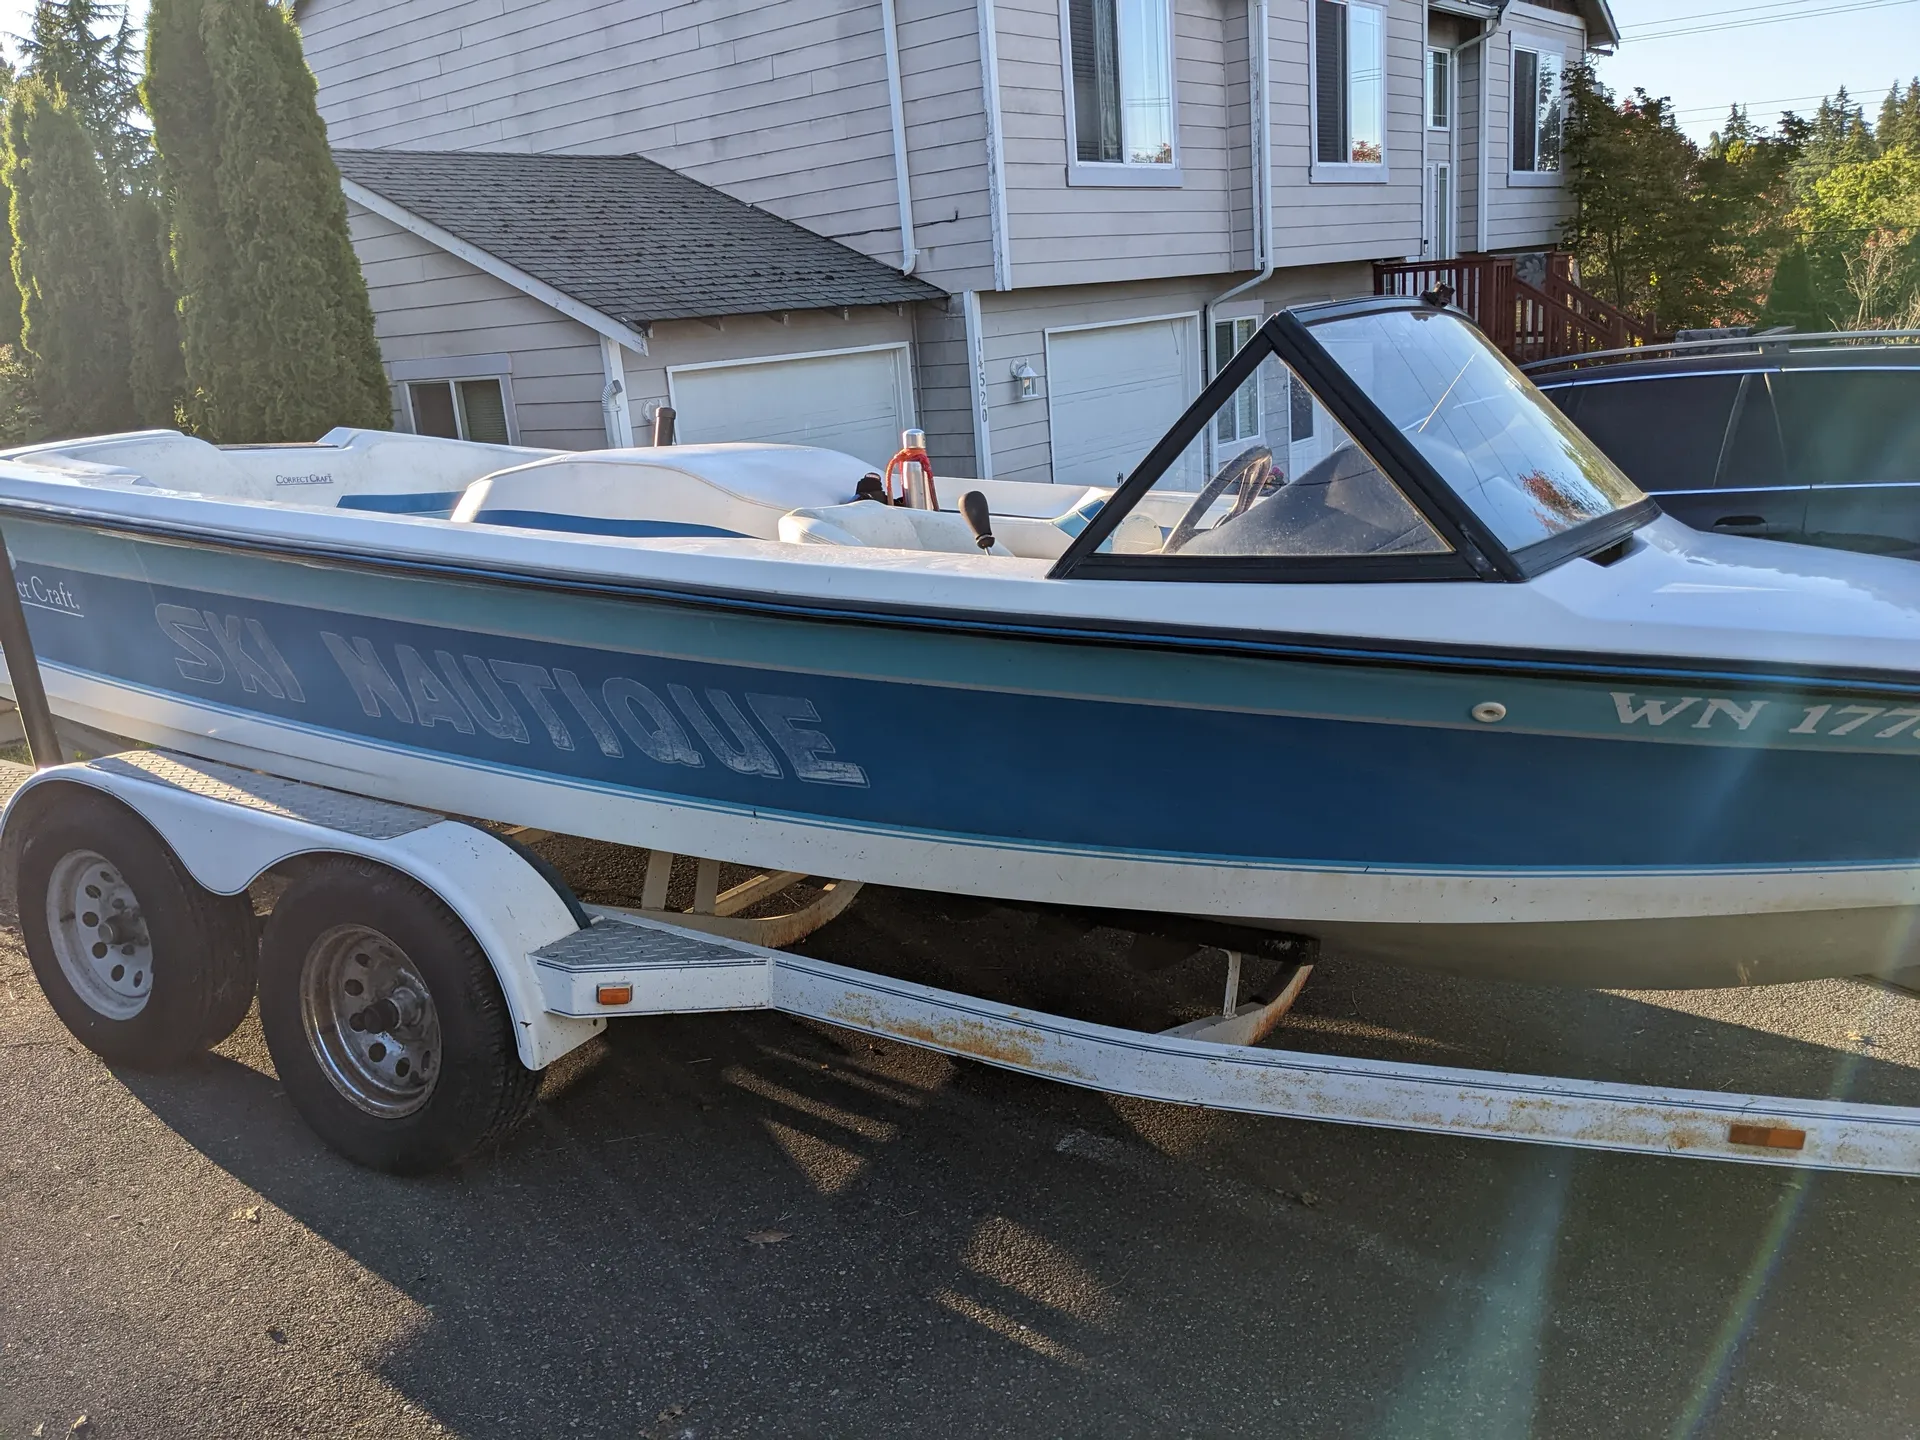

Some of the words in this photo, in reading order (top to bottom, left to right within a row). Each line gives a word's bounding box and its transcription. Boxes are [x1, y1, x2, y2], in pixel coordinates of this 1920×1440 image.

[977, 336, 988, 423] 14520
[155, 603, 306, 703] SKI
[320, 631, 870, 788] NAUTIQUE
[1609, 692, 1770, 730] WN
